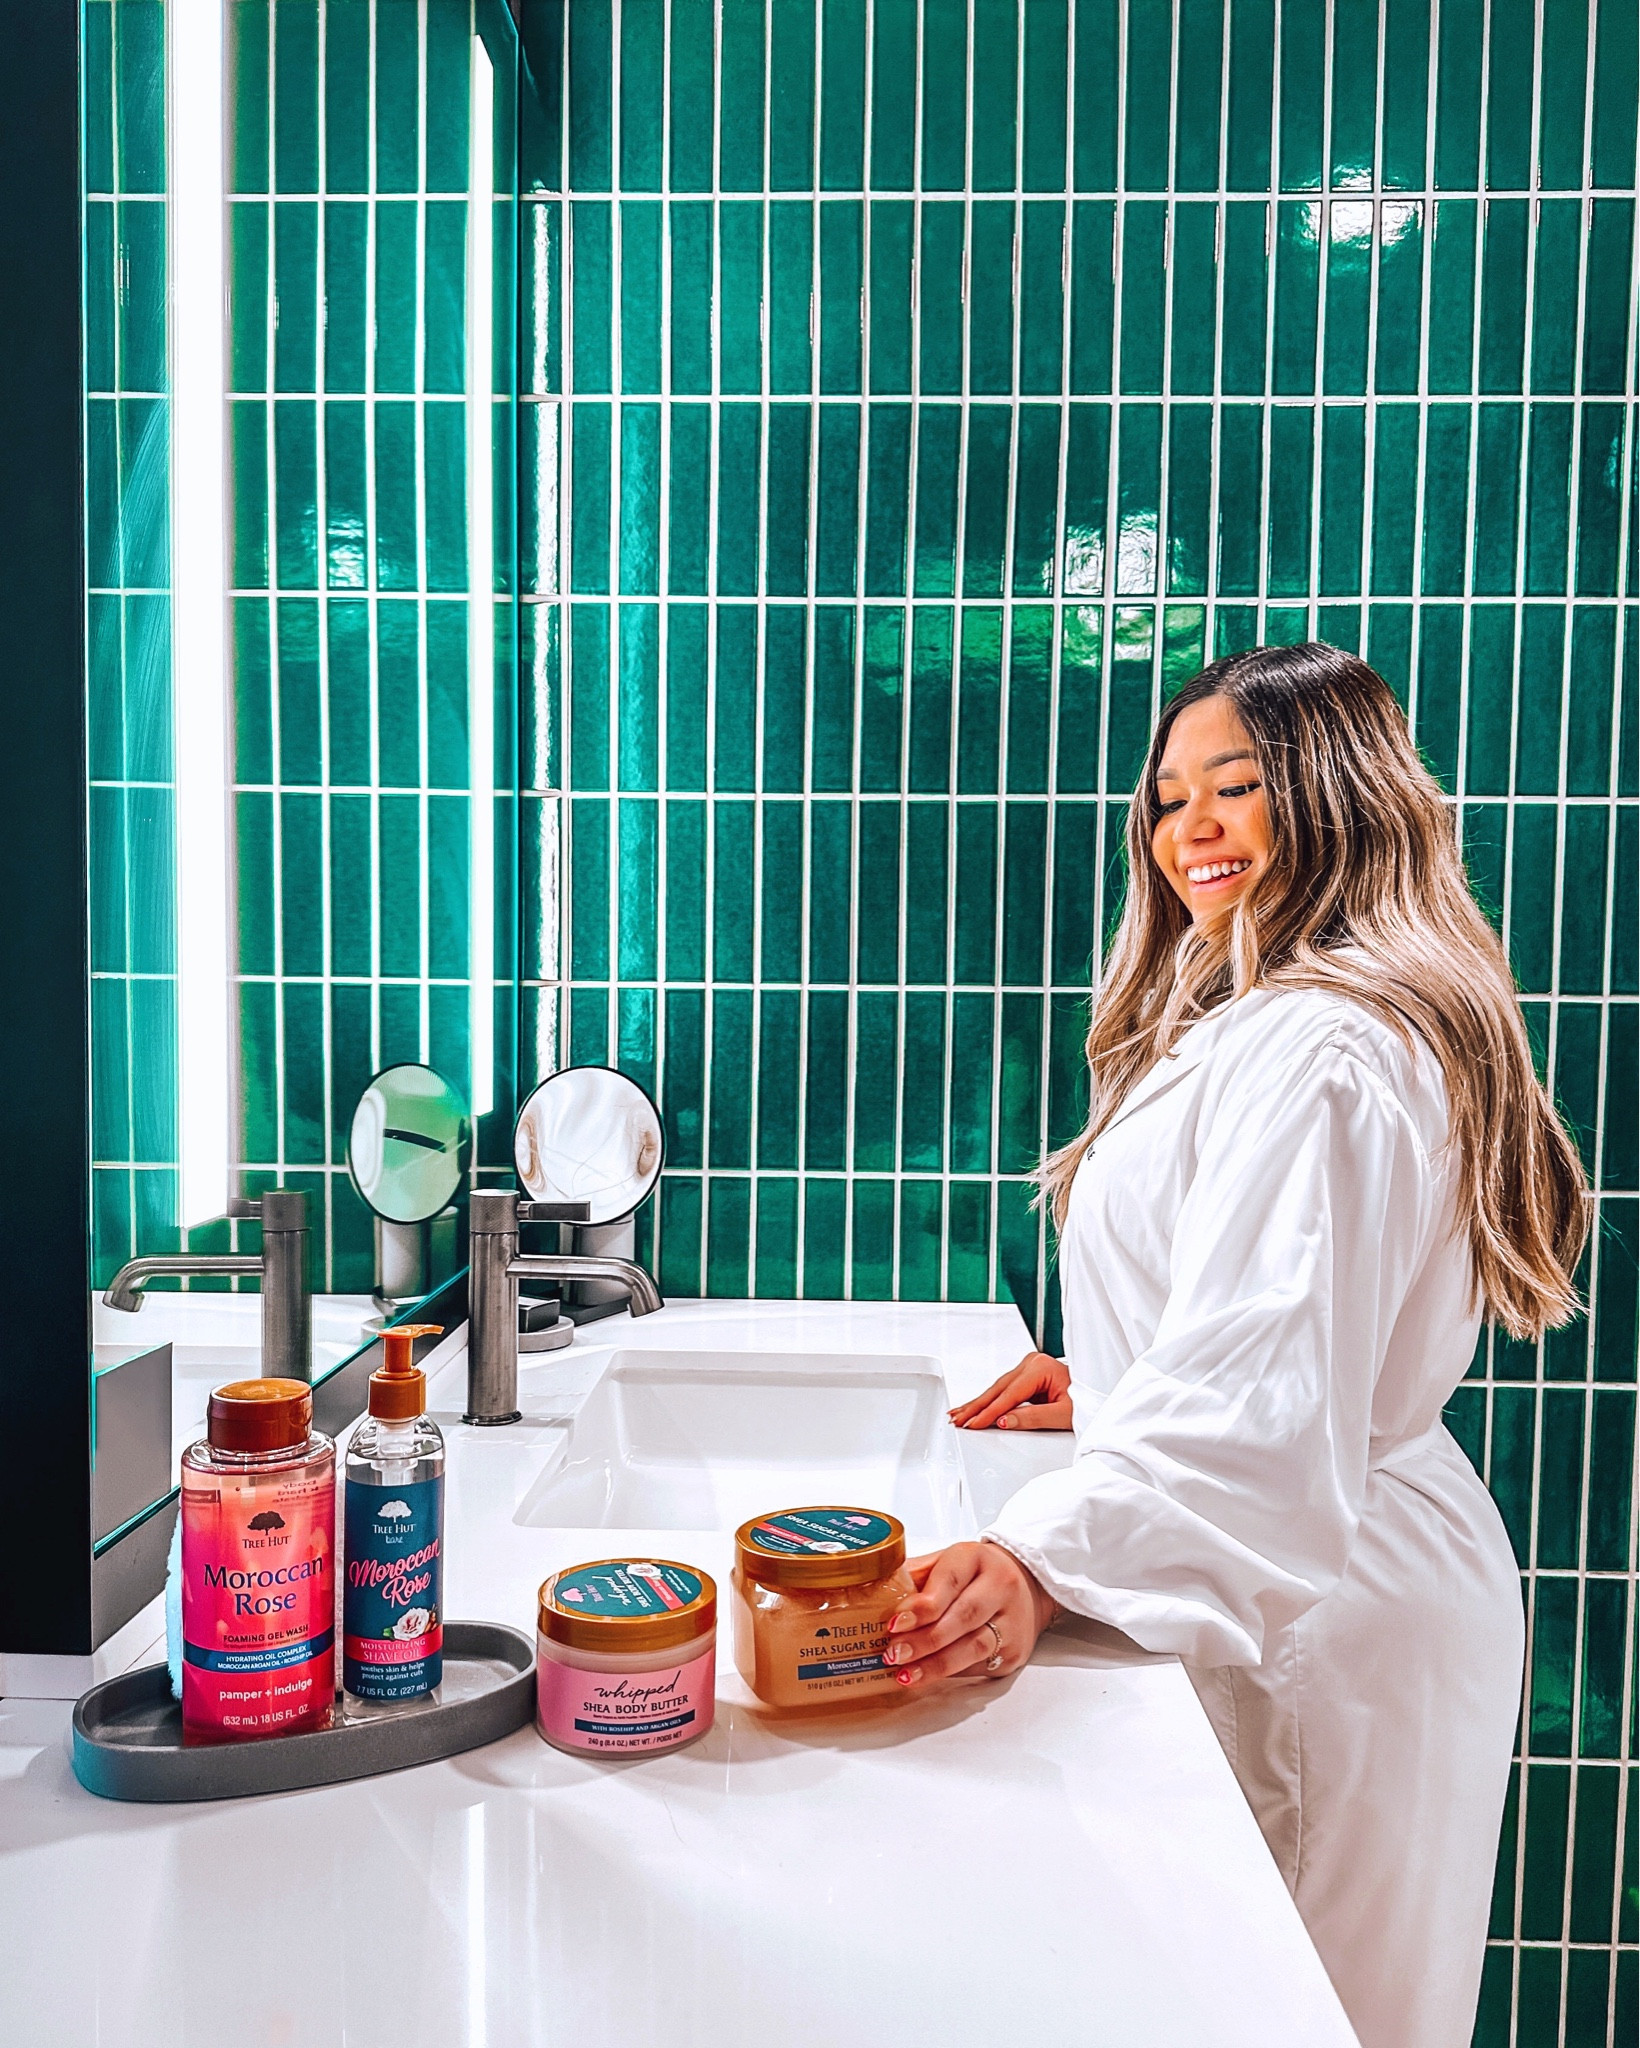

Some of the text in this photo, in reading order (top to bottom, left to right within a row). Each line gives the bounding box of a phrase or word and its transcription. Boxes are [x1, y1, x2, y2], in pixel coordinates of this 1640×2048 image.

[372, 1523, 416, 1534] TREE HUT
[242, 1535, 290, 1549] TREE HUT
[349, 1538, 440, 1588] Moroccan
[203, 1556, 323, 1589] Moroccan
[382, 1571, 432, 1609] Rose
[235, 1592, 297, 1615] Rose
[223, 1634, 265, 1643] FOAMING
[267, 1631, 285, 1640] GEL
[286, 1624, 309, 1637] WASH
[831, 1621, 886, 1639] TREE HUT
[226, 1644, 307, 1662] HYDRATING OIL COMPLEX
[360, 1638, 426, 1651] MOISTURIZING
[800, 1648, 827, 1658] SHEA
[831, 1641, 866, 1654] SUGAR
[869, 1637, 892, 1648] SCR
[363, 1649, 420, 1661] SHAVE OIL
[827, 1661, 861, 1671] Moroccan
[862, 1658, 878, 1666] Rose
[219, 1690, 262, 1702] pamper
[274, 1678, 313, 1696] indulge
[594, 1670, 681, 1704] whipped
[583, 1702, 610, 1713] SHEA
[615, 1704, 647, 1714] BODY
[651, 1695, 689, 1711] BUTTER
[223, 1715, 241, 1726] (532
[242, 1715, 258, 1726] mL)
[261, 1714, 270, 1724] 18
[272, 1711, 284, 1722] US
[592, 1724, 608, 1732] WITH
[588, 1737, 599, 1745] 240
[629, 1738, 640, 1746] NET
